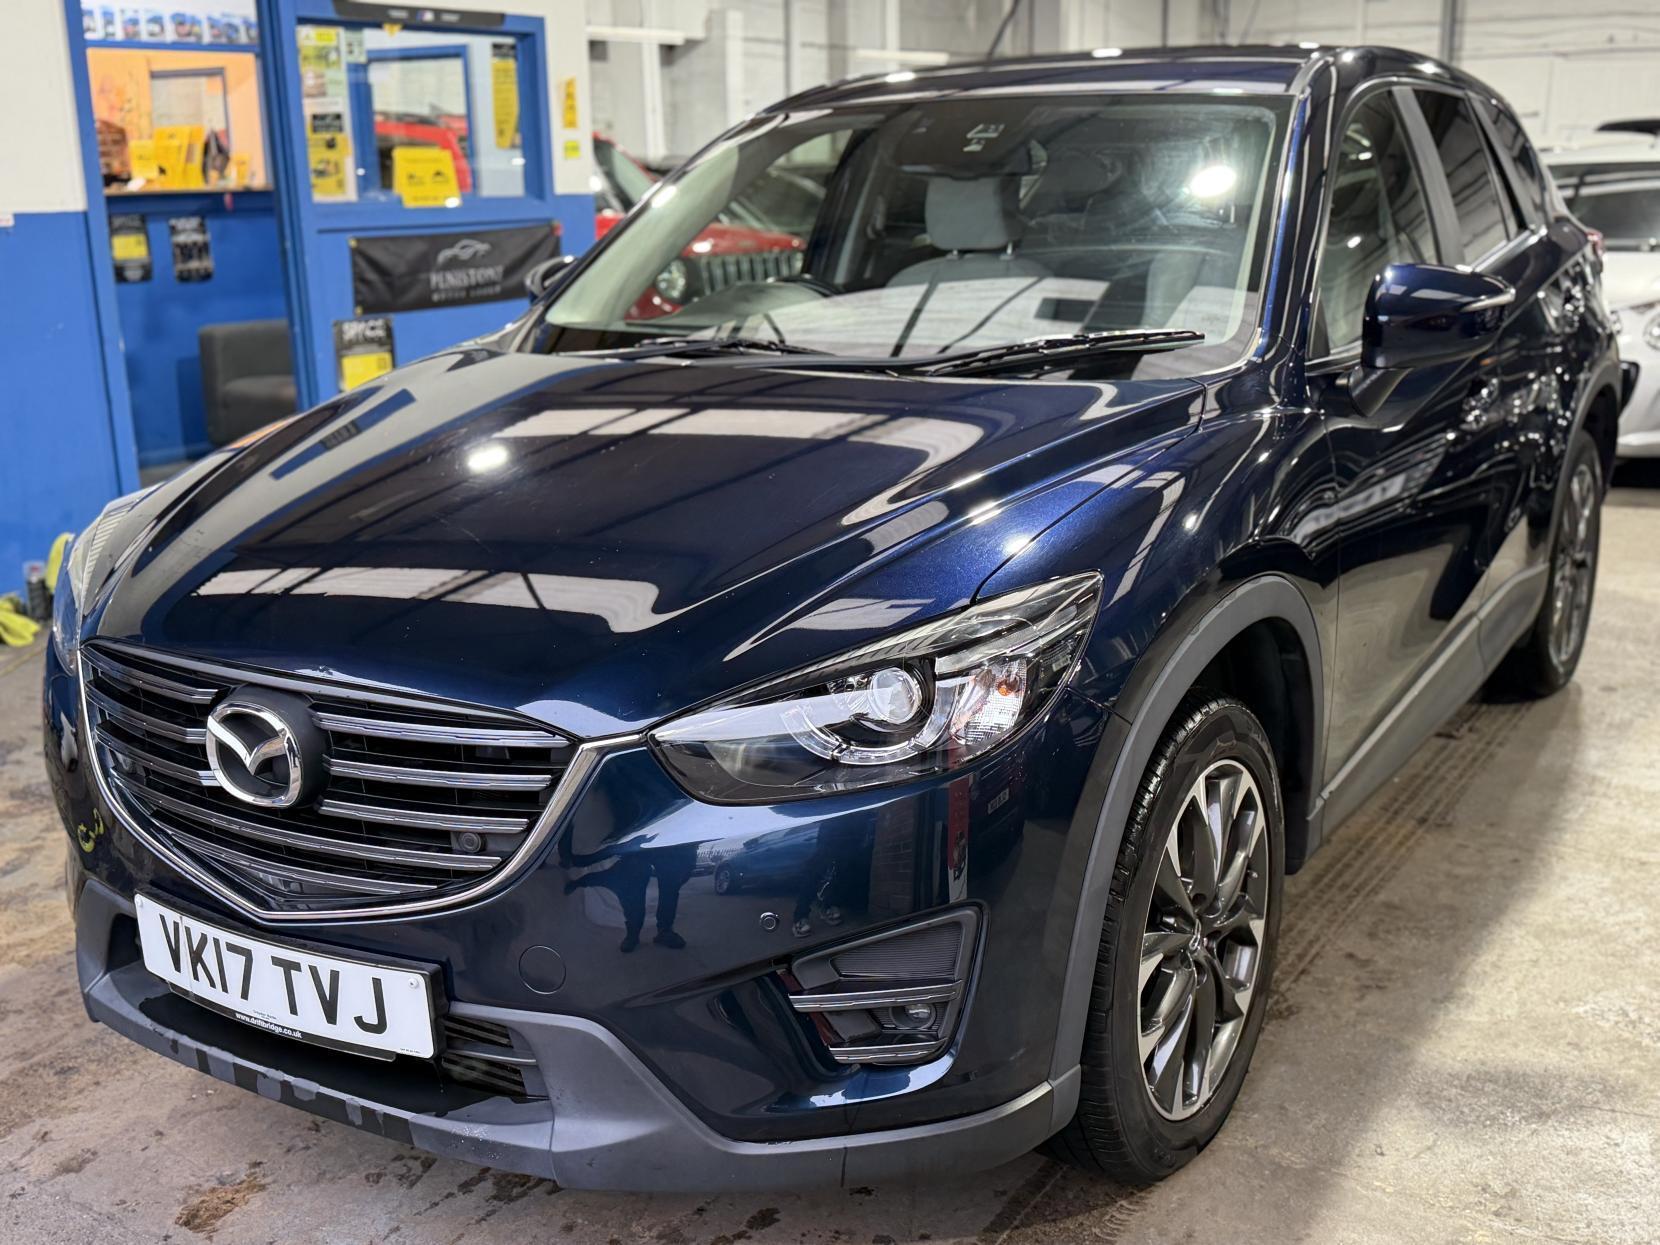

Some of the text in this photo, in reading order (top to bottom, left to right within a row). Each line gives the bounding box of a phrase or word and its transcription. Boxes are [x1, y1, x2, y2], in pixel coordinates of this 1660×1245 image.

[159, 913, 389, 1035] VK17 TVJ
[235, 1012, 303, 1039] www.driftbridge.co.uk
